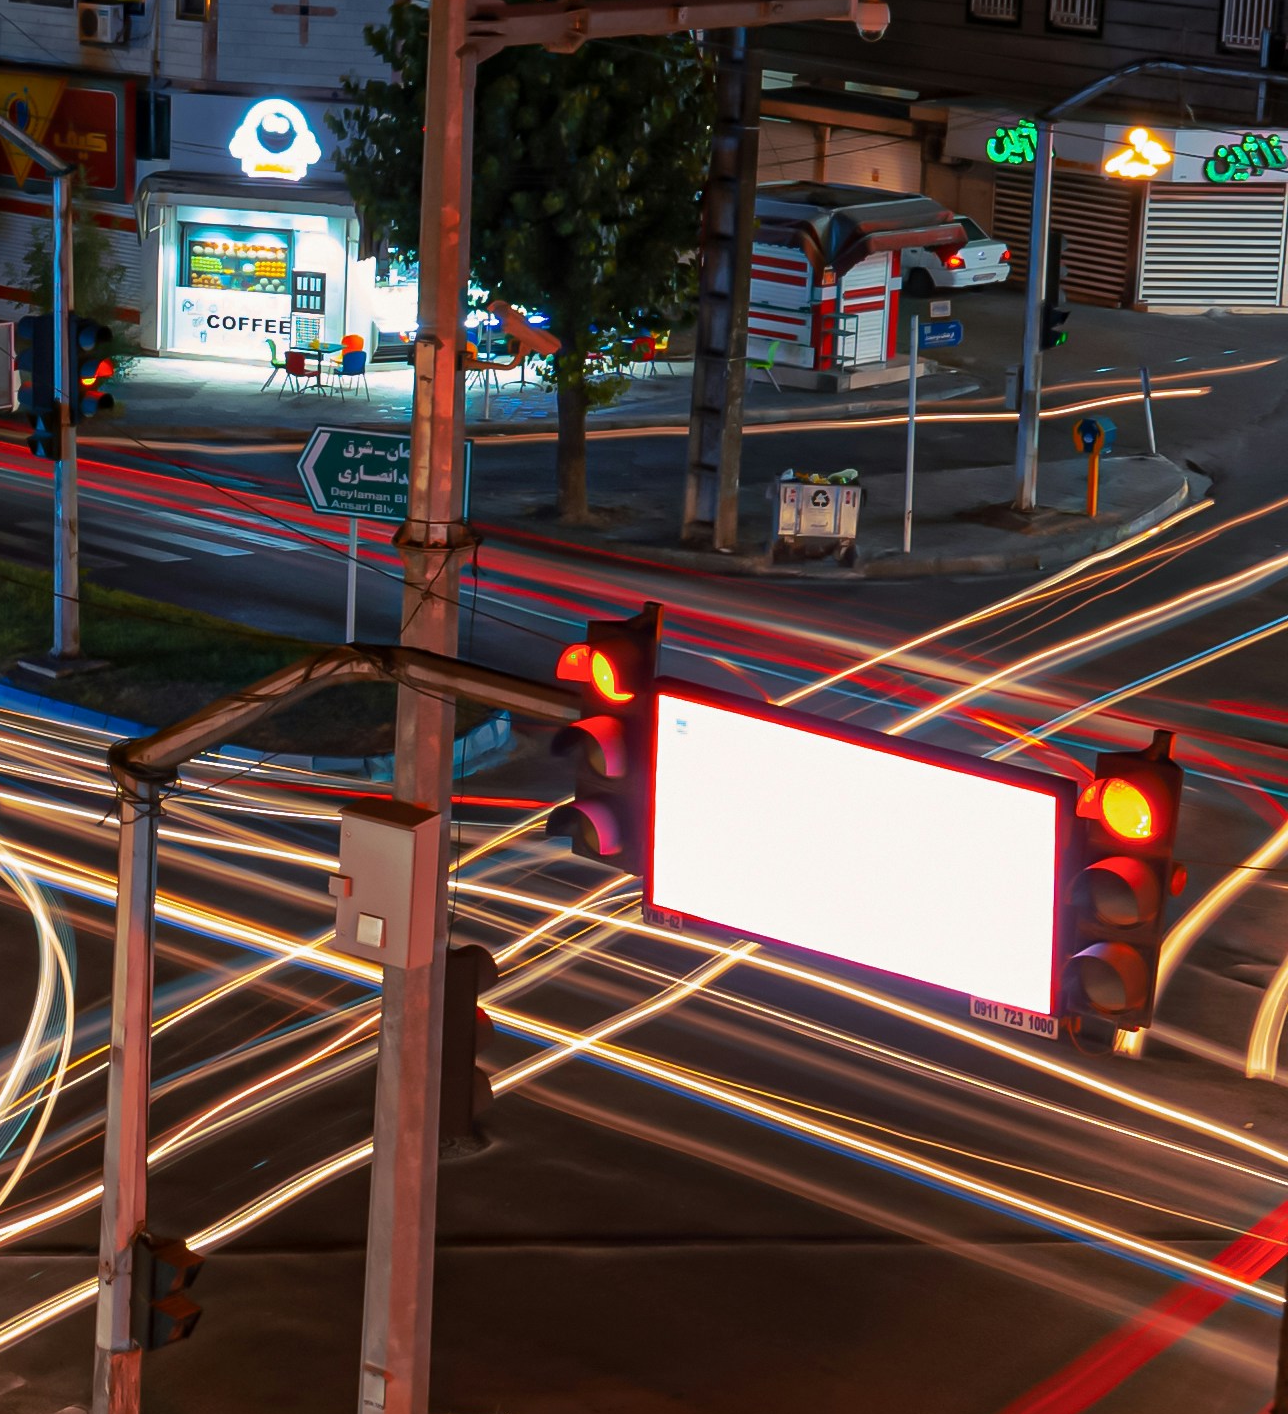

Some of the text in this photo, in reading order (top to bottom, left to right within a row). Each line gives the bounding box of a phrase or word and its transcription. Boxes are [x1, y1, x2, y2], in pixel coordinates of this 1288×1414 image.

[206, 314, 291, 335] COFFEE
[330, 486, 391, 502] Deylaman
[330, 499, 371, 512] Ansari
[974, 999, 1054, 1035] 0911 723 1000
